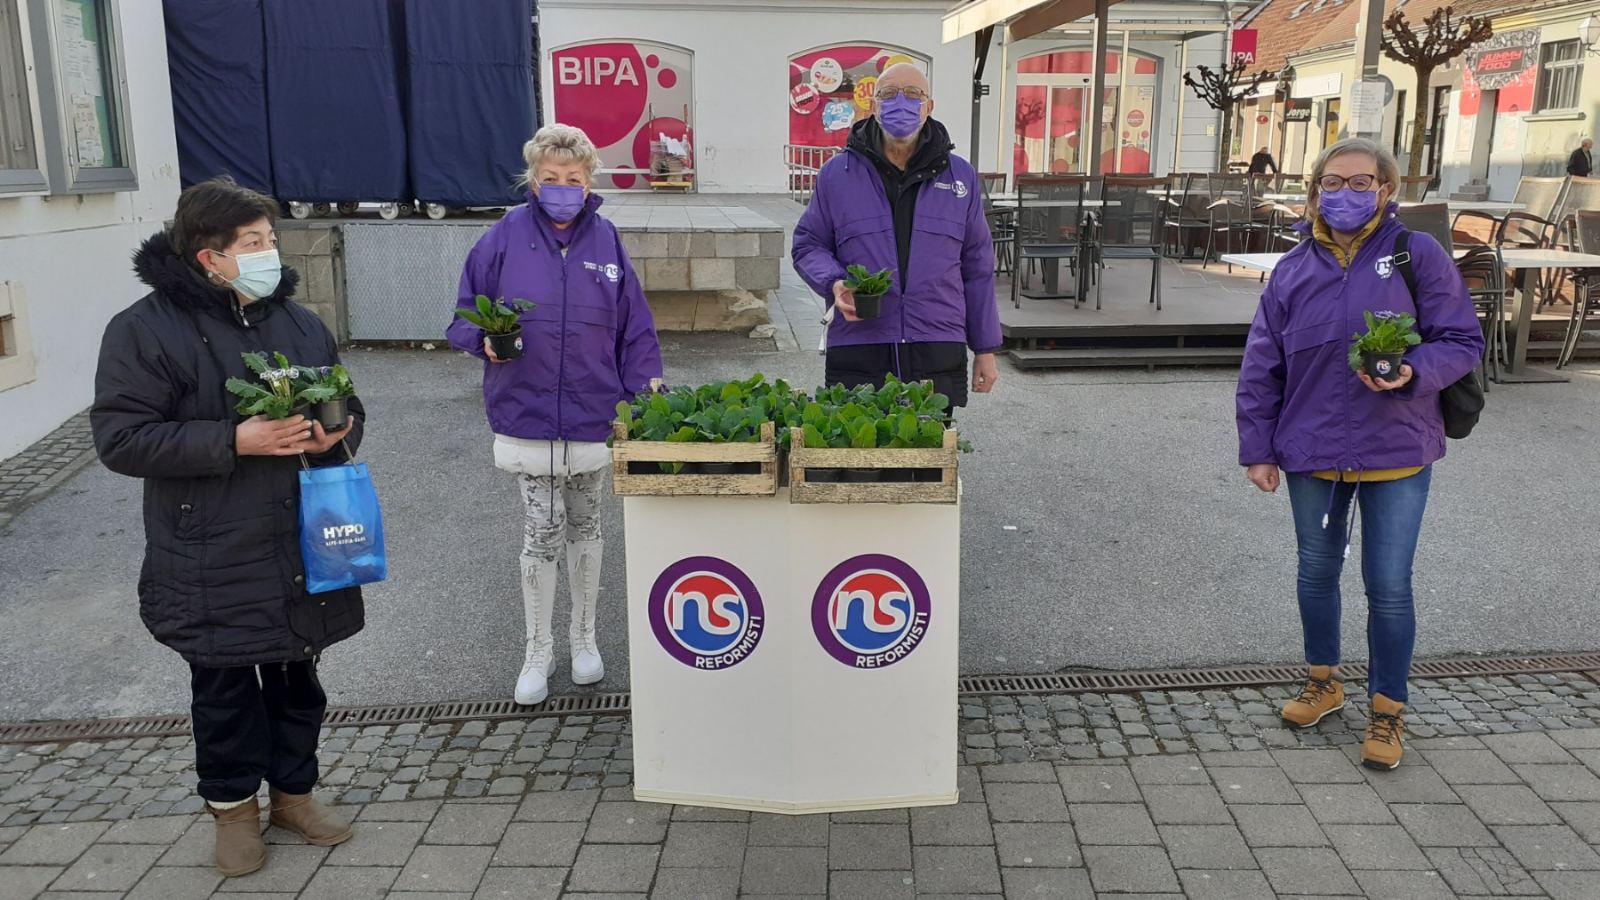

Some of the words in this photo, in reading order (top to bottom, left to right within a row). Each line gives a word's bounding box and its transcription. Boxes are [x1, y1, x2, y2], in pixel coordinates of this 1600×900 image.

[558, 57, 640, 86] BIPA
[1232, 51, 1255, 63] IPA
[1478, 60, 1512, 71] FOOD
[1286, 108, 1311, 119] Jorge
[323, 523, 364, 539] HYPO
[673, 591, 740, 635] ns
[836, 589, 908, 633] ns
[695, 616, 762, 668] REFORMISTI
[856, 612, 928, 667] REFORMISTI
